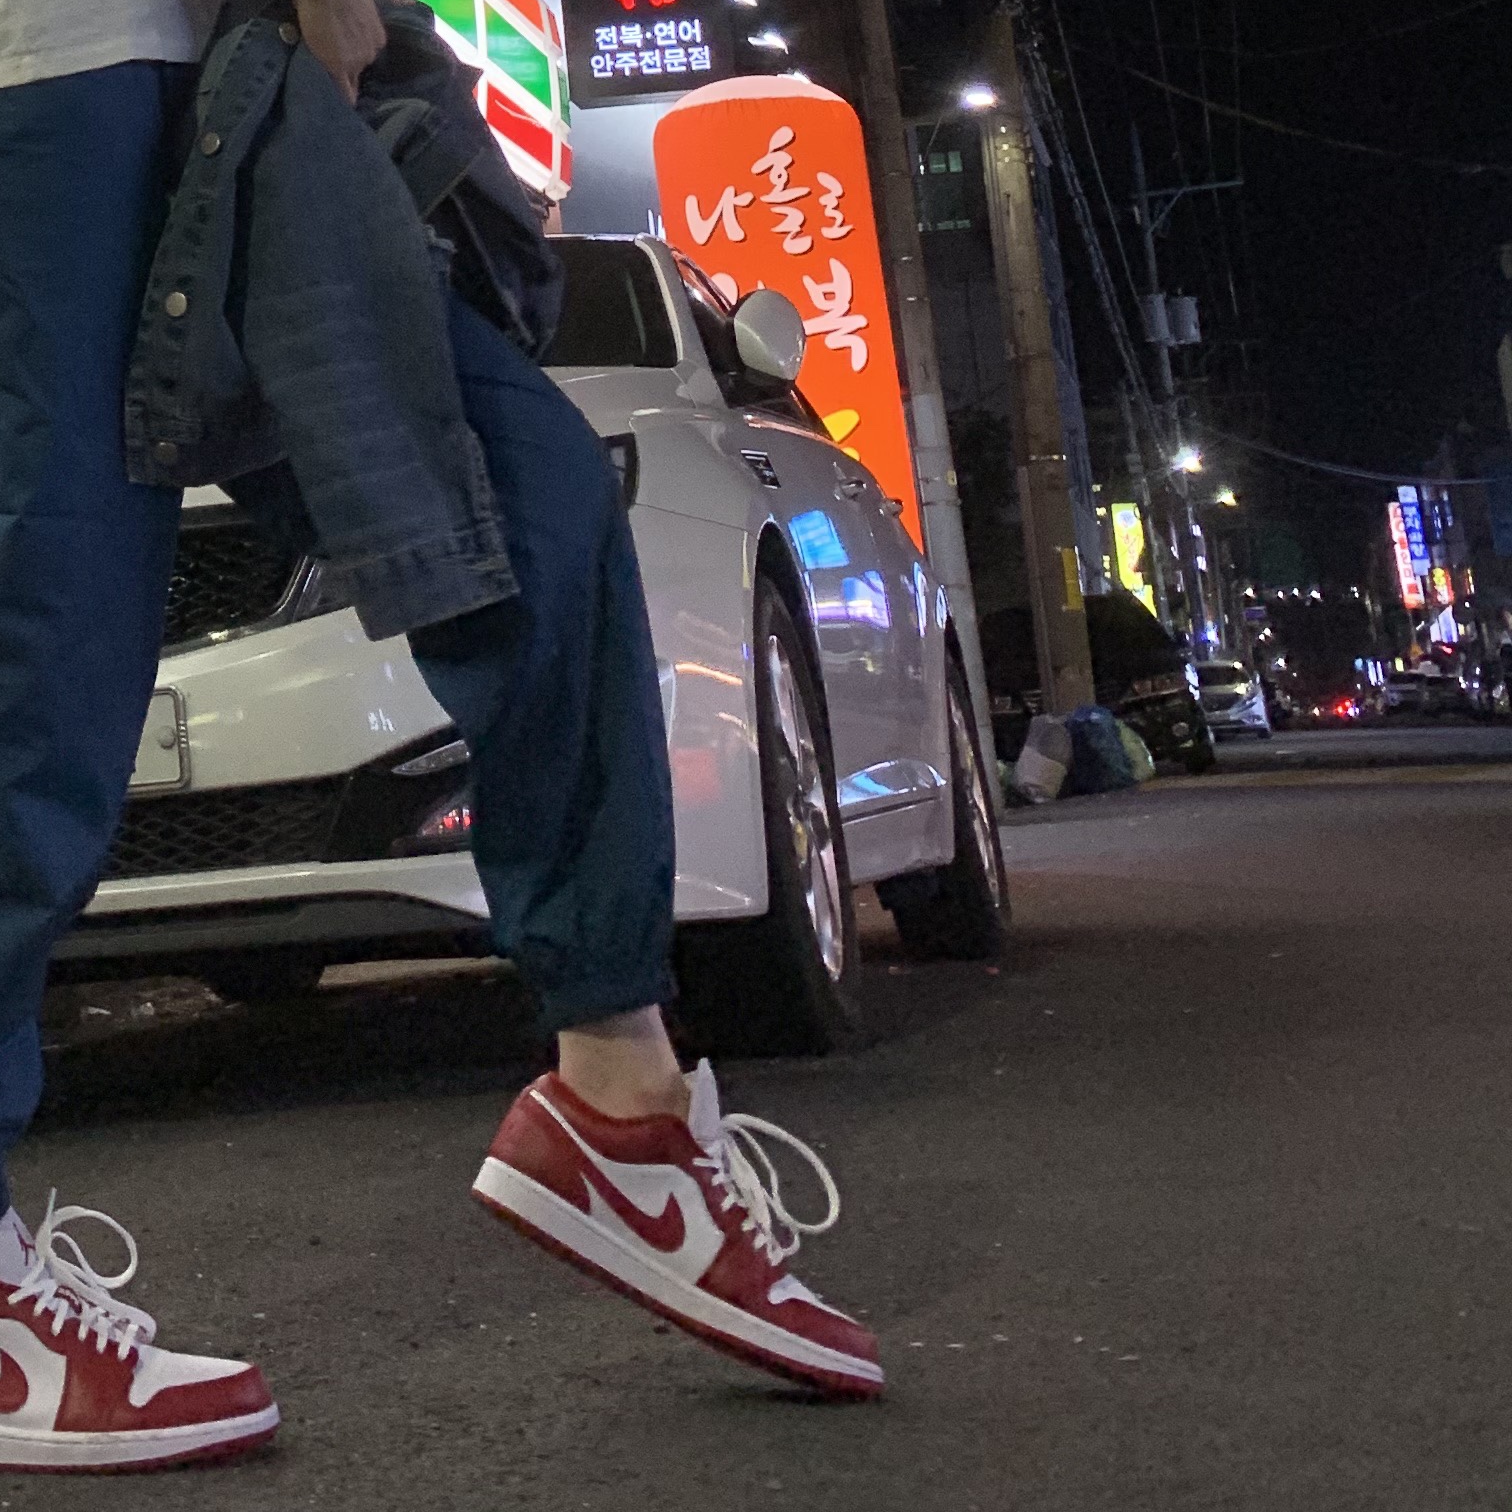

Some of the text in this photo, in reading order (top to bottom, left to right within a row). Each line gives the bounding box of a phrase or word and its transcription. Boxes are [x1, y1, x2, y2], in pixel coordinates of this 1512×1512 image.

[594, 18, 702, 51] 전복·연어
[590, 45, 712, 78] 안주전문점
[685, 125, 855, 255] 나홀로
